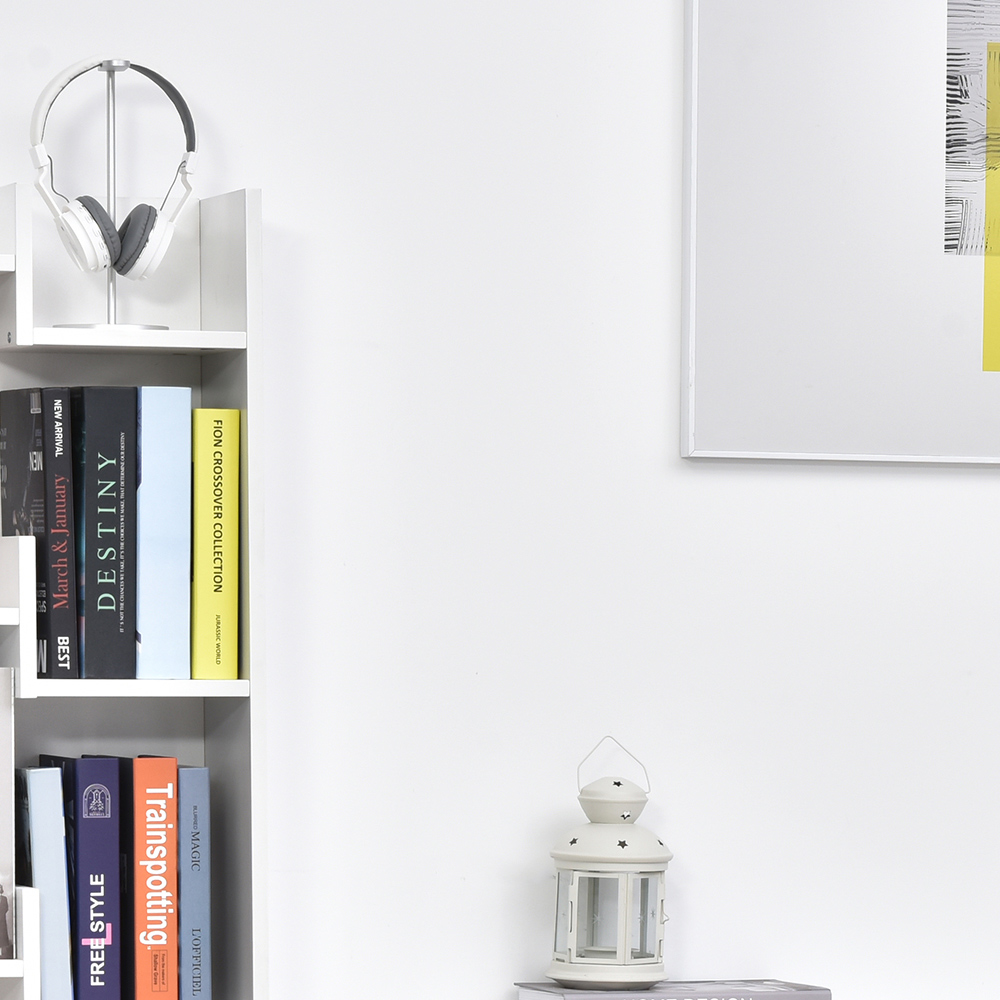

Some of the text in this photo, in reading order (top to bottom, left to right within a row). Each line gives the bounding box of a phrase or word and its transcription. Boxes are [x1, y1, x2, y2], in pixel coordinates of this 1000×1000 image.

[54, 399, 64, 458] NEW ARRIVAL
[51, 473, 70, 609] March & January
[97, 452, 117, 612] DESTINY
[213, 420, 223, 593] FION CROSSOVER COLLECTION
[57, 636, 70, 670] BEST
[190, 831, 201, 872] MAGIC
[90, 874, 105, 986] FREE STYLE
[191, 928, 201, 997] L'OFFICIEL
